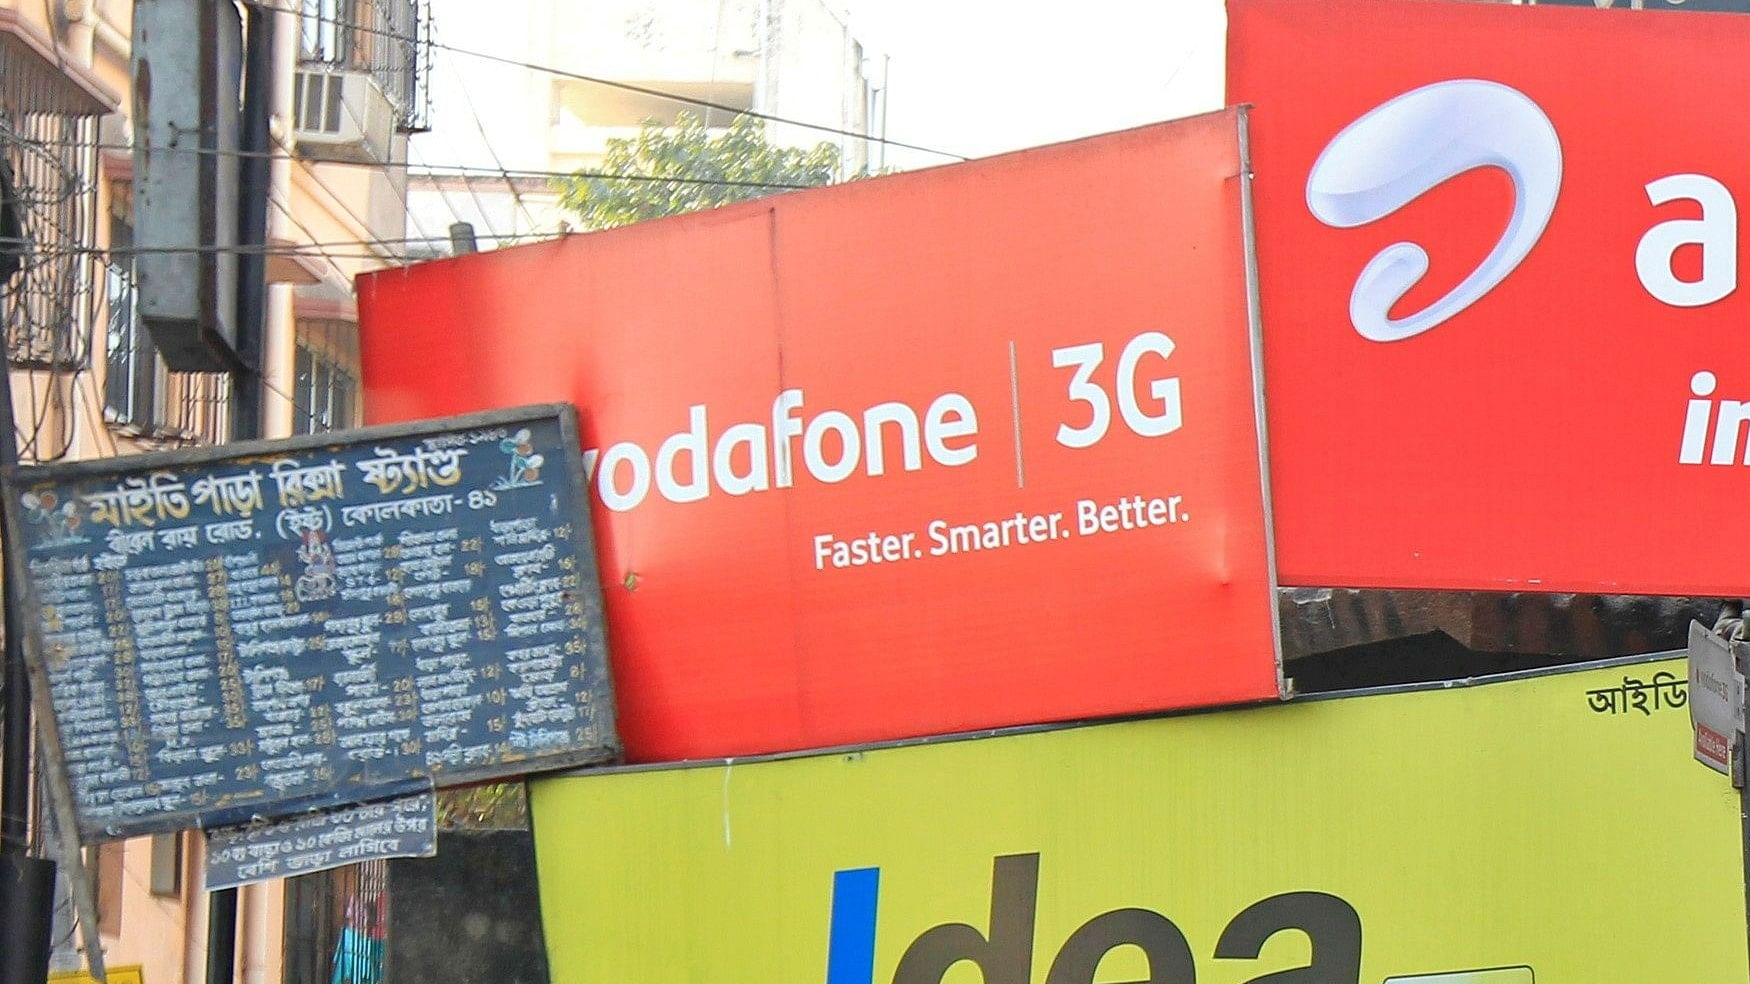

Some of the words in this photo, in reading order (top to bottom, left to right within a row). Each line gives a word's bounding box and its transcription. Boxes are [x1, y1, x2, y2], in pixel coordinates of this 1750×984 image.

[1051, 331, 1184, 449] 3G
[83, 472, 191, 528] মাইতি
[813, 531, 922, 570] Faster.
[928, 511, 1070, 557] Smarter.
[1076, 494, 1190, 536] Better.
[1585, 671, 1688, 717] আইডি
